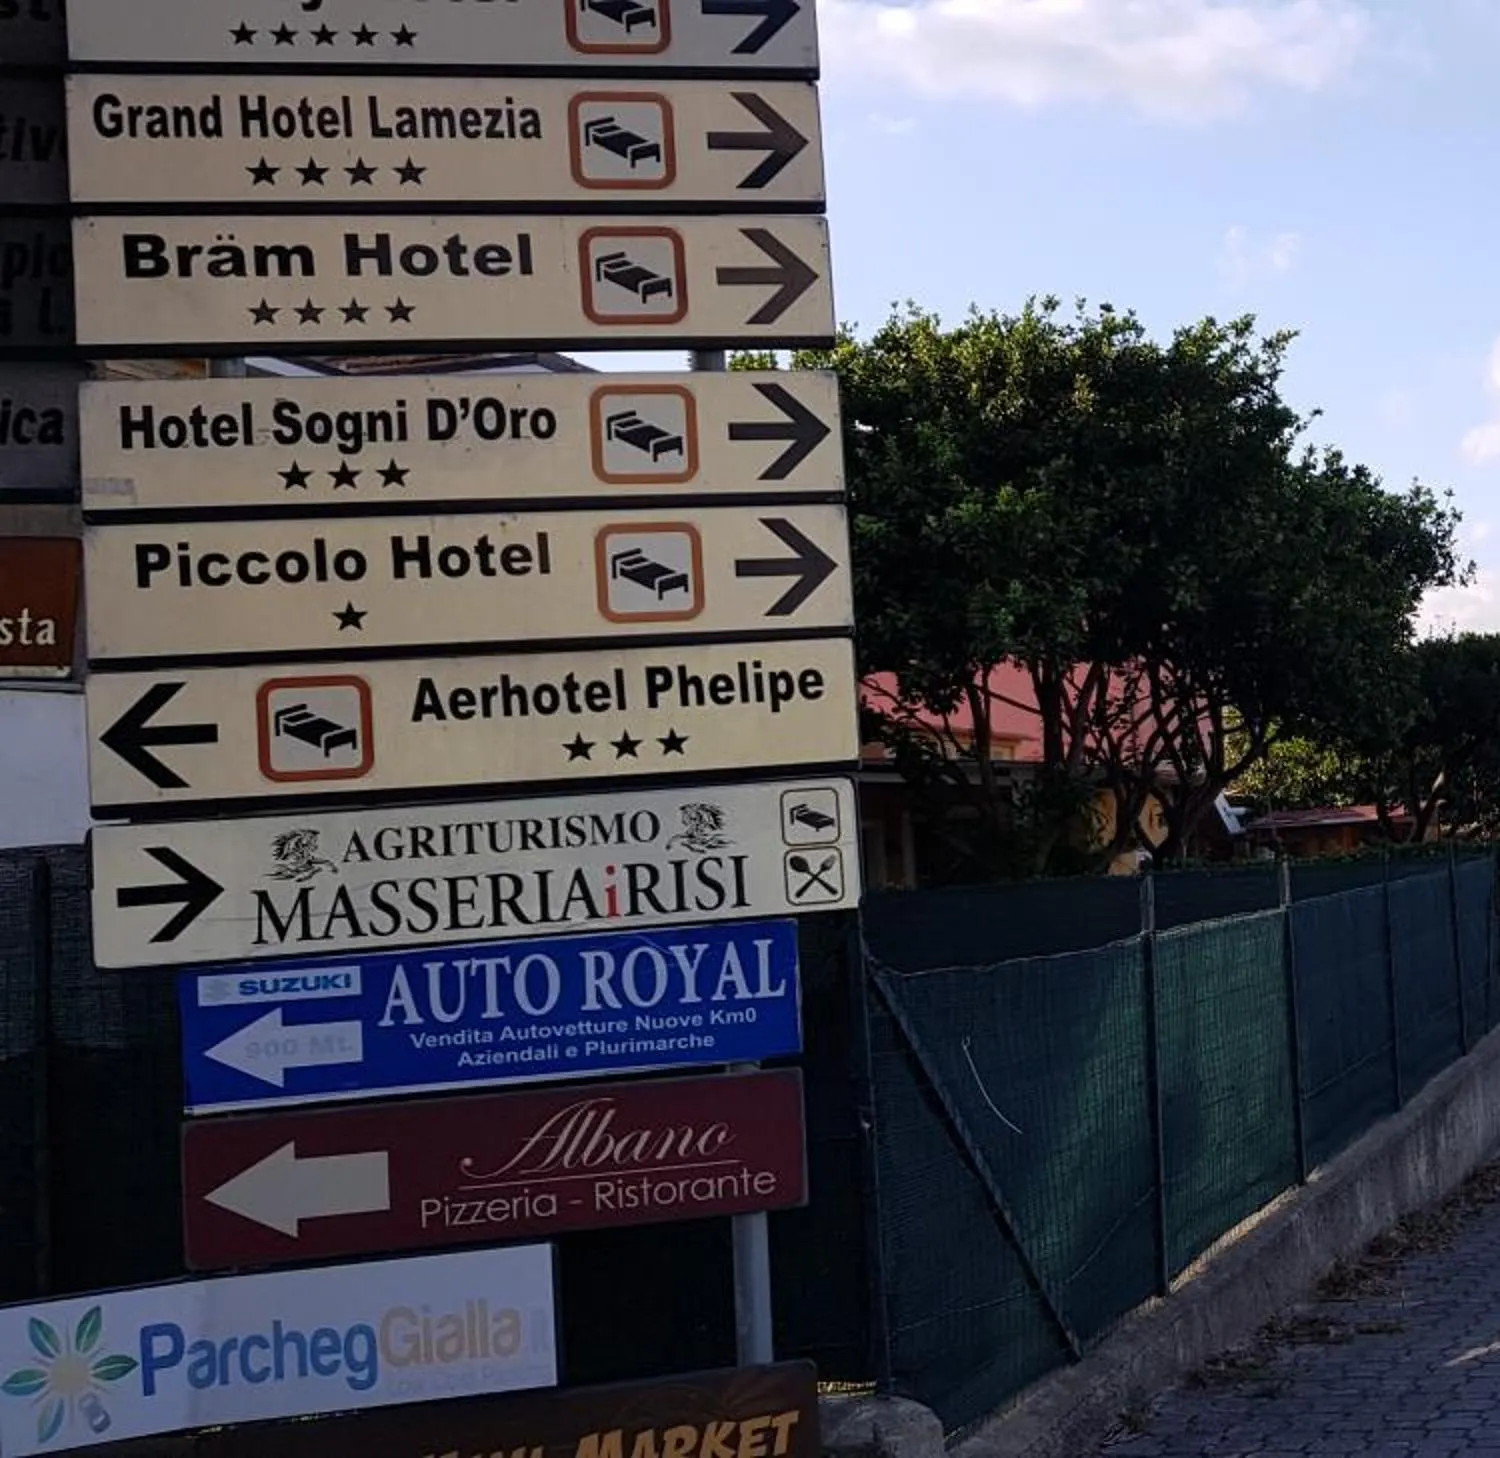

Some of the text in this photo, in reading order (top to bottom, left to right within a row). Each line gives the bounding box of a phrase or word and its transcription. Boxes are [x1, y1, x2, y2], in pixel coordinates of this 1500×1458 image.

[92, 93, 542, 140] Grand Hotel Lamezia
[122, 232, 534, 279] Bräm Hotel
[119, 396, 557, 455] Hotel Sogni D'Oro
[134, 531, 552, 589] Piccolo Hotel
[410, 659, 825, 723] Aerhotel Phelipe
[342, 809, 661, 863] AGRITURISMO
[238, 972, 353, 997] SUZUKI
[376, 938, 787, 1028] AUTO ROYAL
[410, 1028, 494, 1049] Vendita
[500, 1020, 629, 1042] Autovetture
[634, 1012, 704, 1032] Nuove
[457, 1033, 716, 1068] Aziendali e Plurimarche
[459, 1096, 738, 1180] Albano
[420, 1188, 558, 1228] Pizzeria
[593, 1167, 778, 1211] Ristorante
[574, 1409, 801, 1458] MARKET
